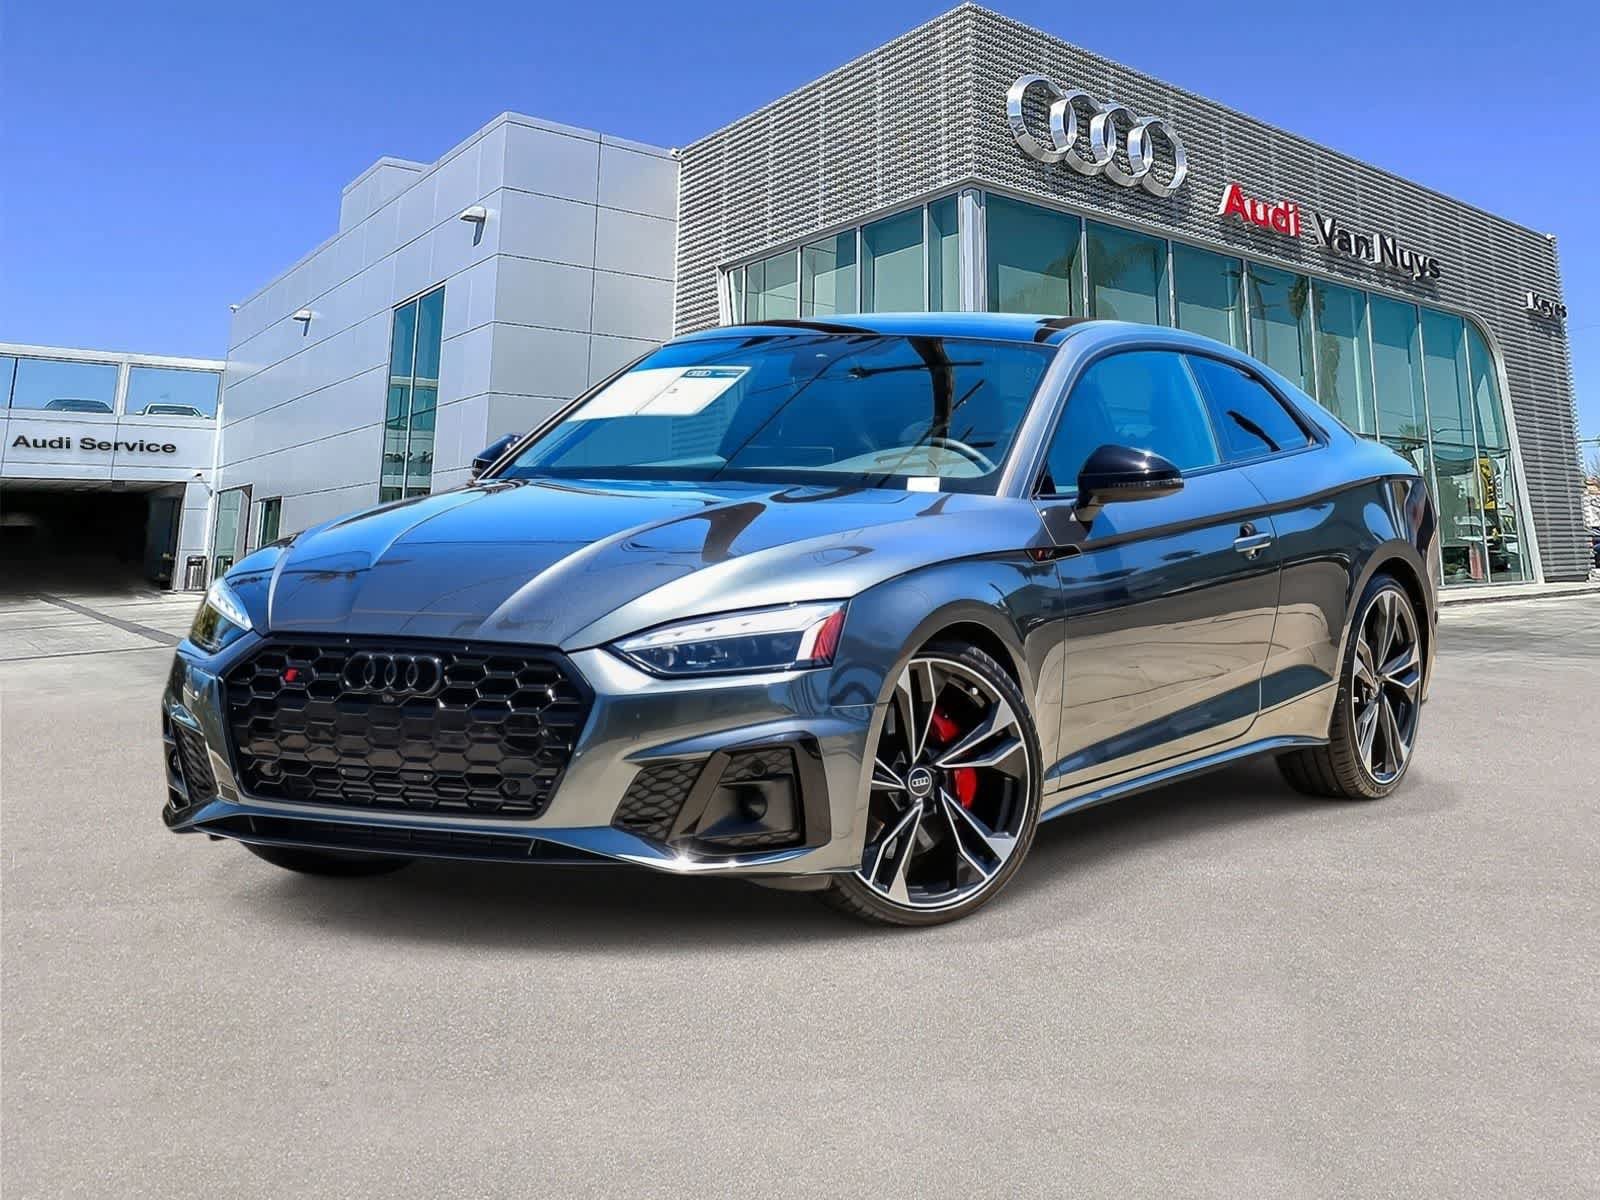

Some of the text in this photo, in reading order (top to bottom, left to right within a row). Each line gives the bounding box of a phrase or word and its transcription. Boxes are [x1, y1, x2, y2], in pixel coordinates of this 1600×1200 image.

[1218, 182, 1441, 280] Audi Van Nuys
[12, 434, 177, 454] Audi Service
